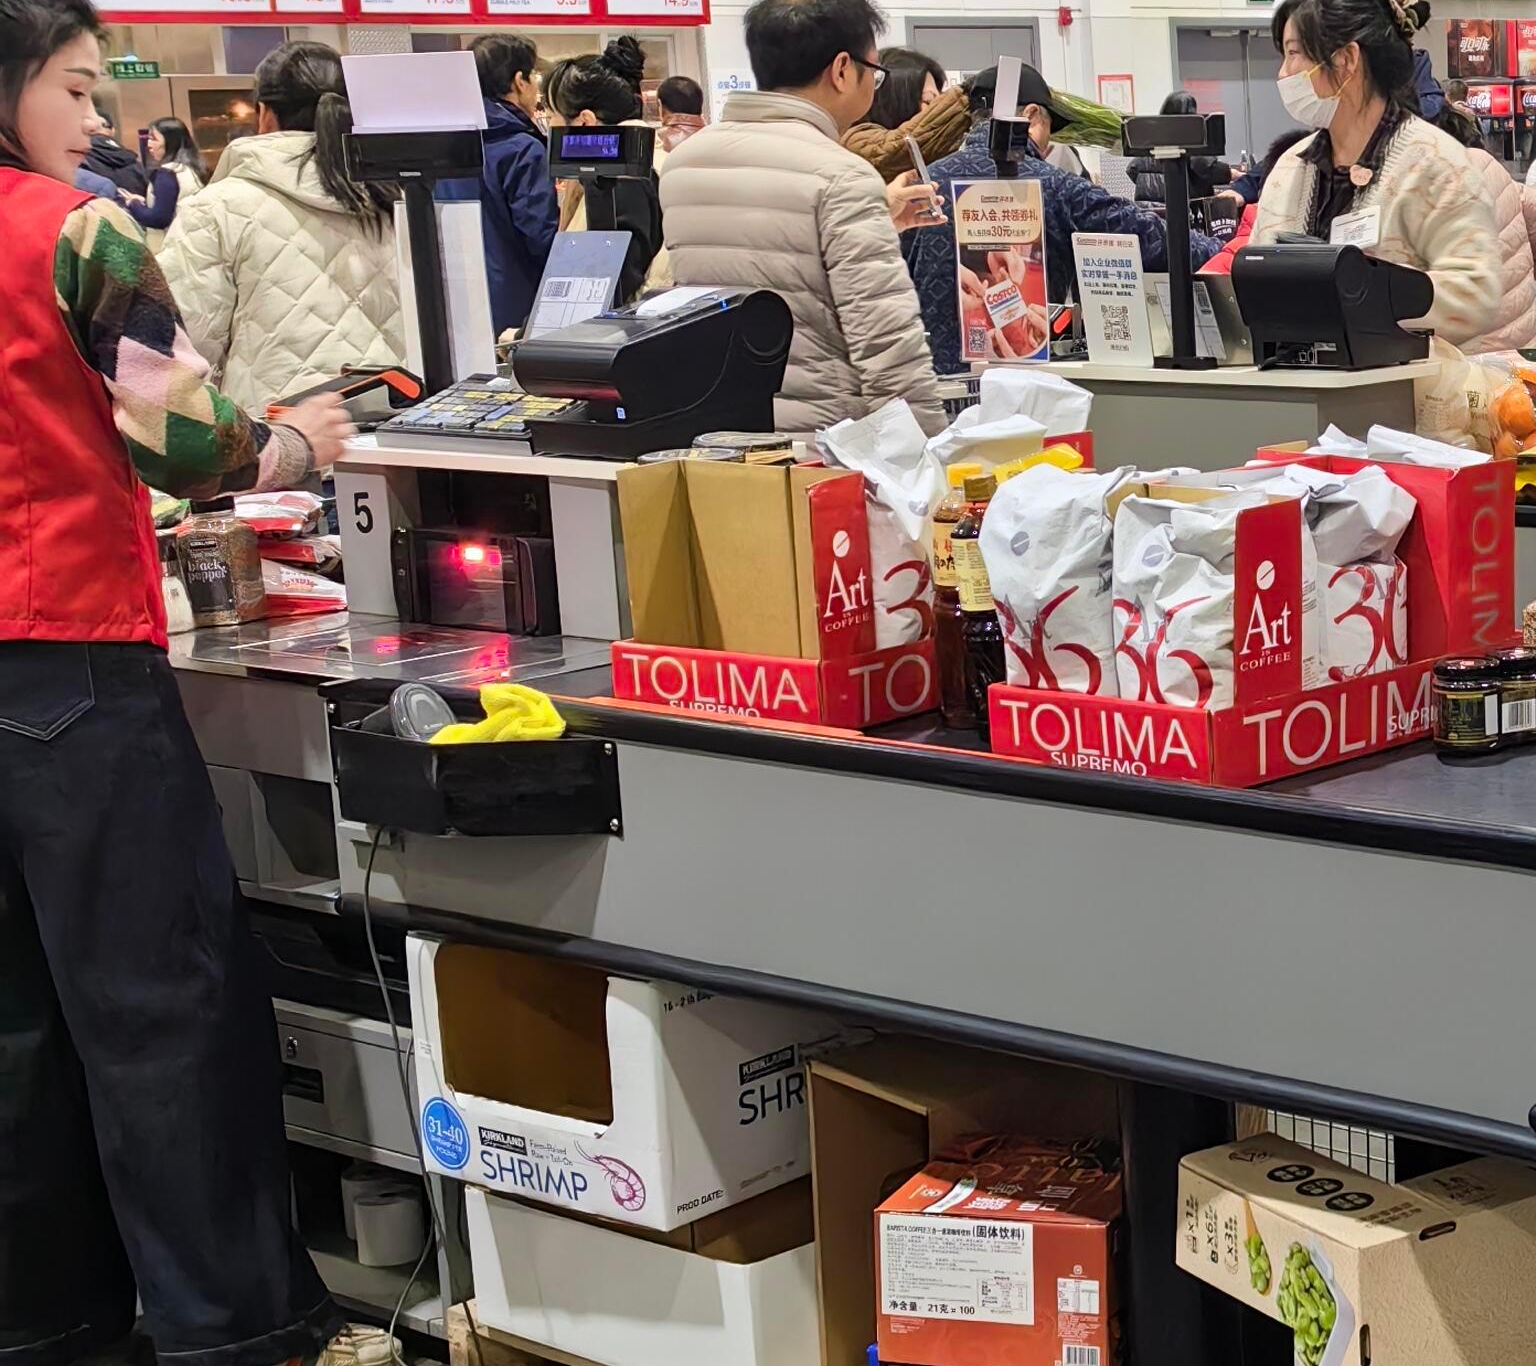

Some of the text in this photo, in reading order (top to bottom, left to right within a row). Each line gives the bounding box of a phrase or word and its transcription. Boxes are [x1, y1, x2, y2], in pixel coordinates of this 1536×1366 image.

[354, 492, 374, 534] 5
[187, 560, 224, 572] black
[823, 560, 870, 618] Art
[1471, 477, 1499, 649] TOLIM
[1239, 592, 1292, 654] Art
[621, 653, 808, 713] TOLIMA
[1240, 651, 1291, 671] COFFEE
[1000, 699, 1197, 768] TOLIMA
[1051, 751, 1148, 777] SUPREMO
[481, 1129, 525, 1147] KIRKLAND
[480, 1149, 588, 1201] SHRIMP
